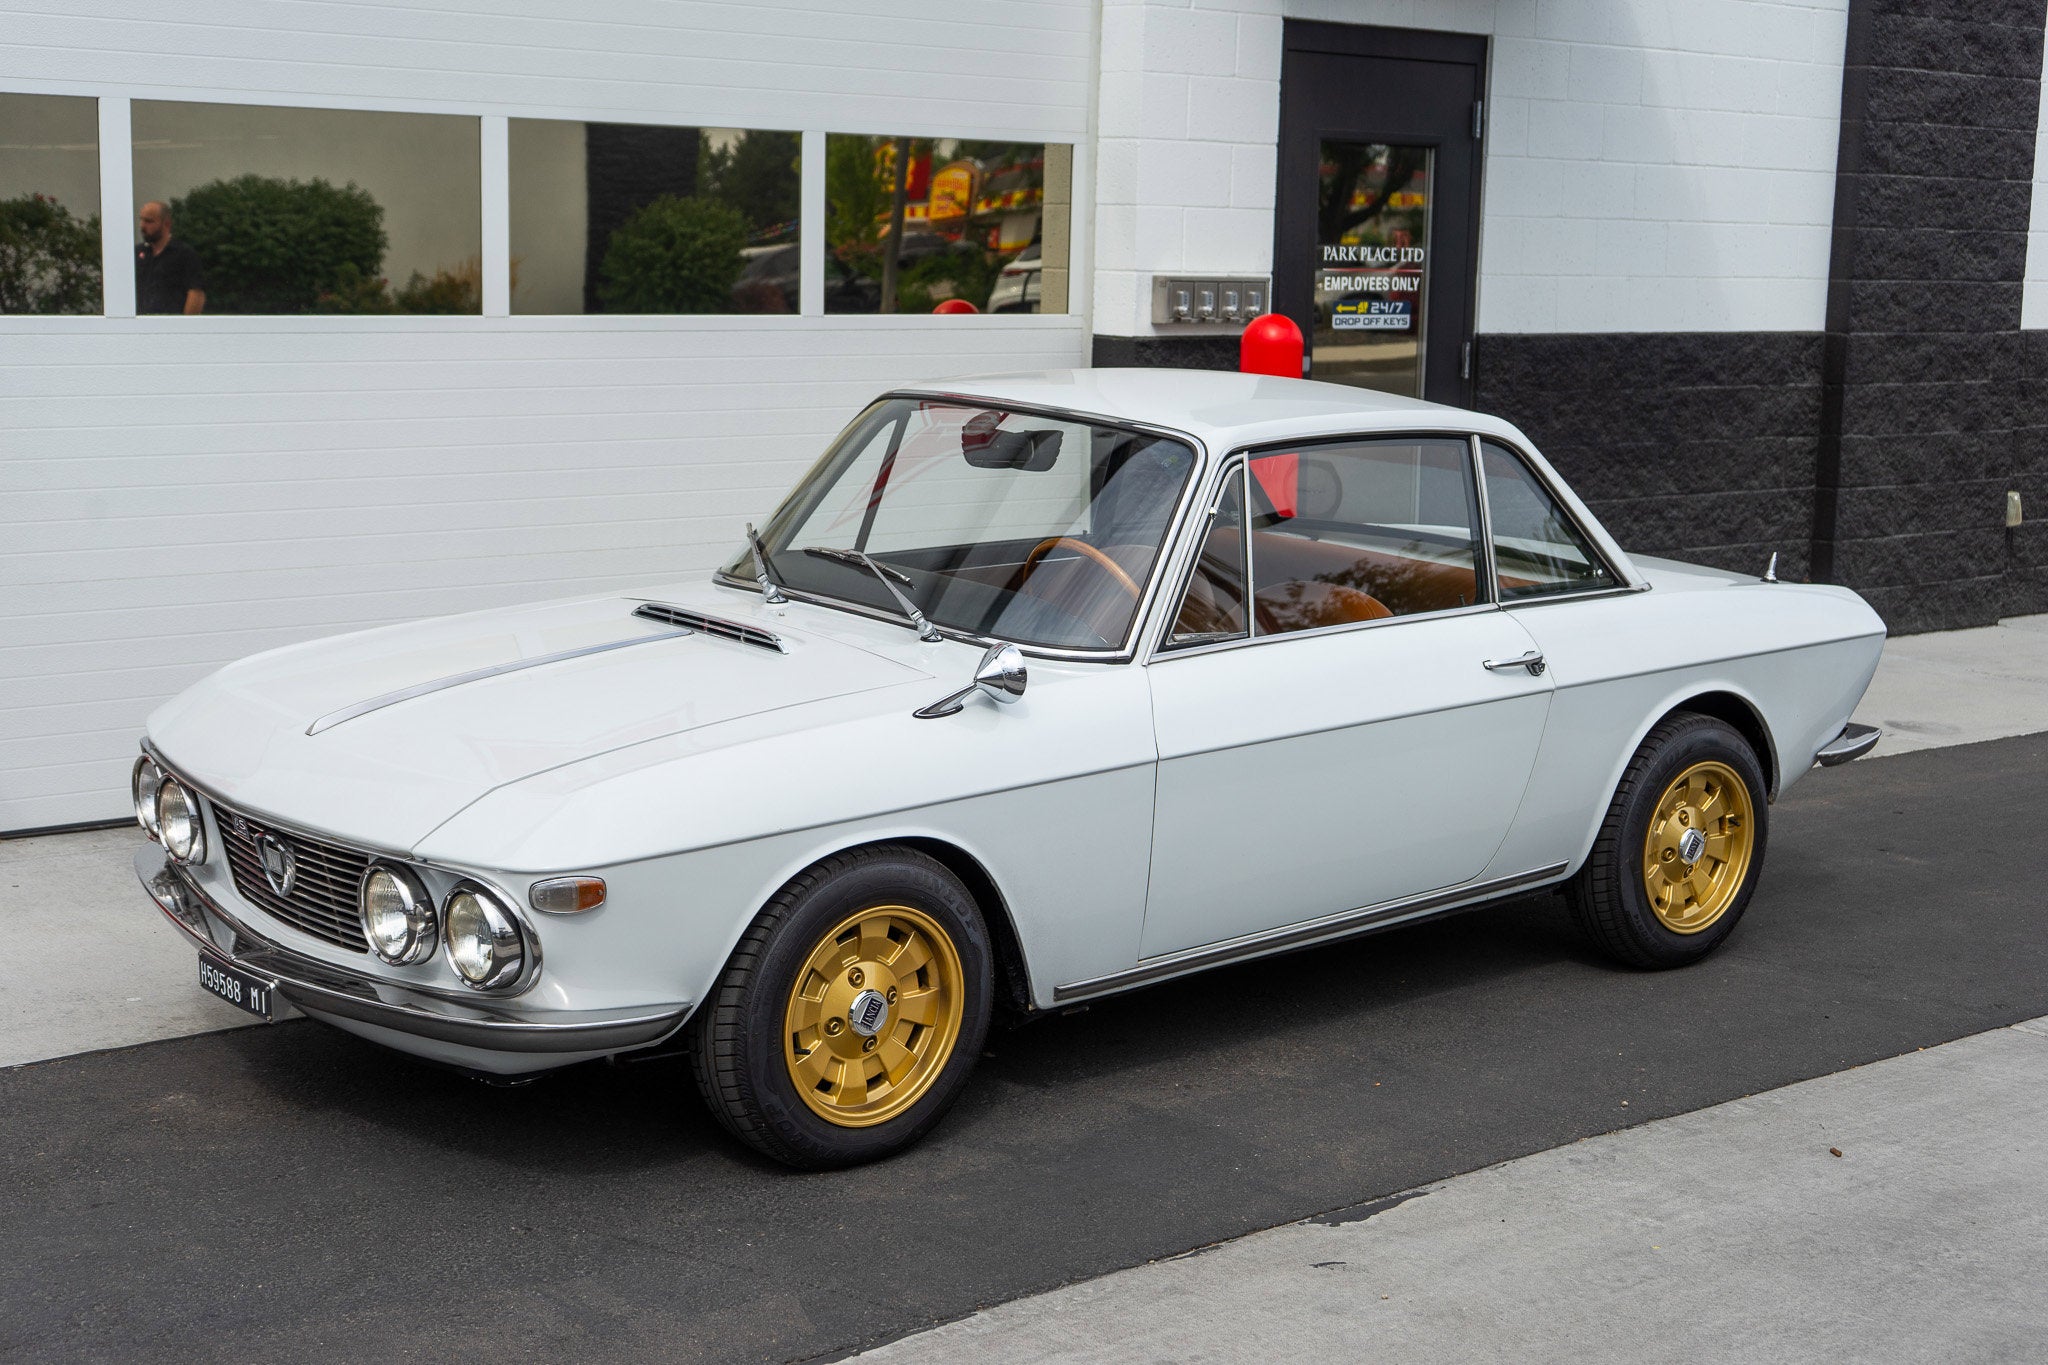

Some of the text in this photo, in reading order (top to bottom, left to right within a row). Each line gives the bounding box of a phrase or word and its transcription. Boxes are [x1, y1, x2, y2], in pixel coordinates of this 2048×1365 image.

[1323, 246, 1424, 262] PARK PLACE LTD
[1324, 276, 1420, 291] EMPLOYEES ONLY
[1371, 302, 1403, 313] 24/7
[1335, 317, 1408, 326] DROP OFF KEYS
[200, 961, 265, 1014] H59588 MI
[862, 1000, 882, 1027] LANCIA
